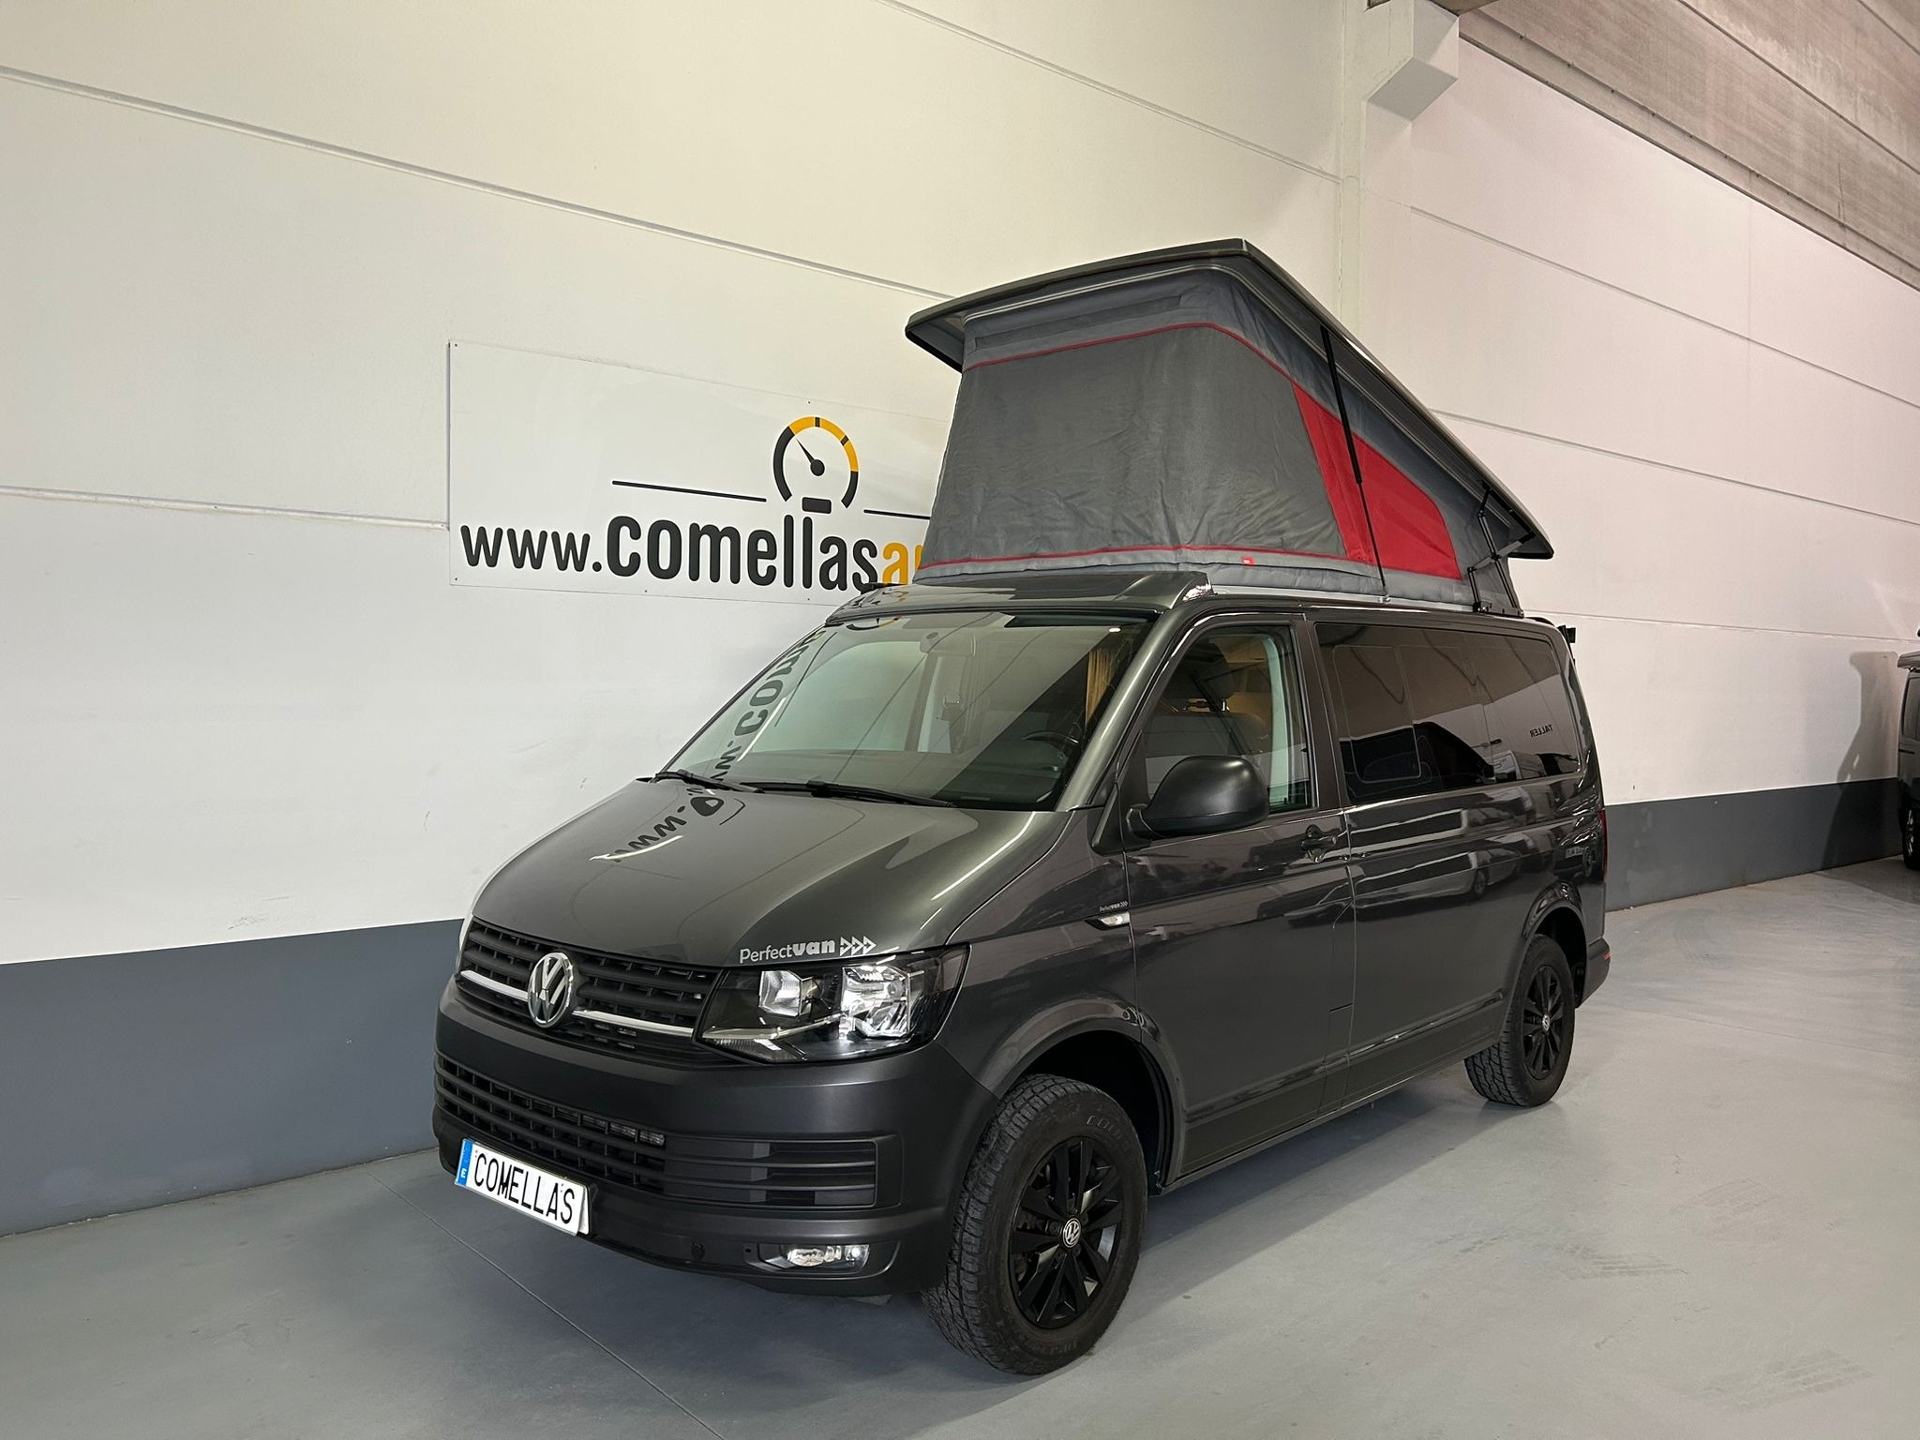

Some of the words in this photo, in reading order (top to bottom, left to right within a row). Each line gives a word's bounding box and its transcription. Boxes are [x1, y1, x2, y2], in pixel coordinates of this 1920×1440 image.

[740, 940, 835, 963] Perfectvan
[460, 1168, 467, 1178] E
[474, 1153, 575, 1224] COMELLAS
